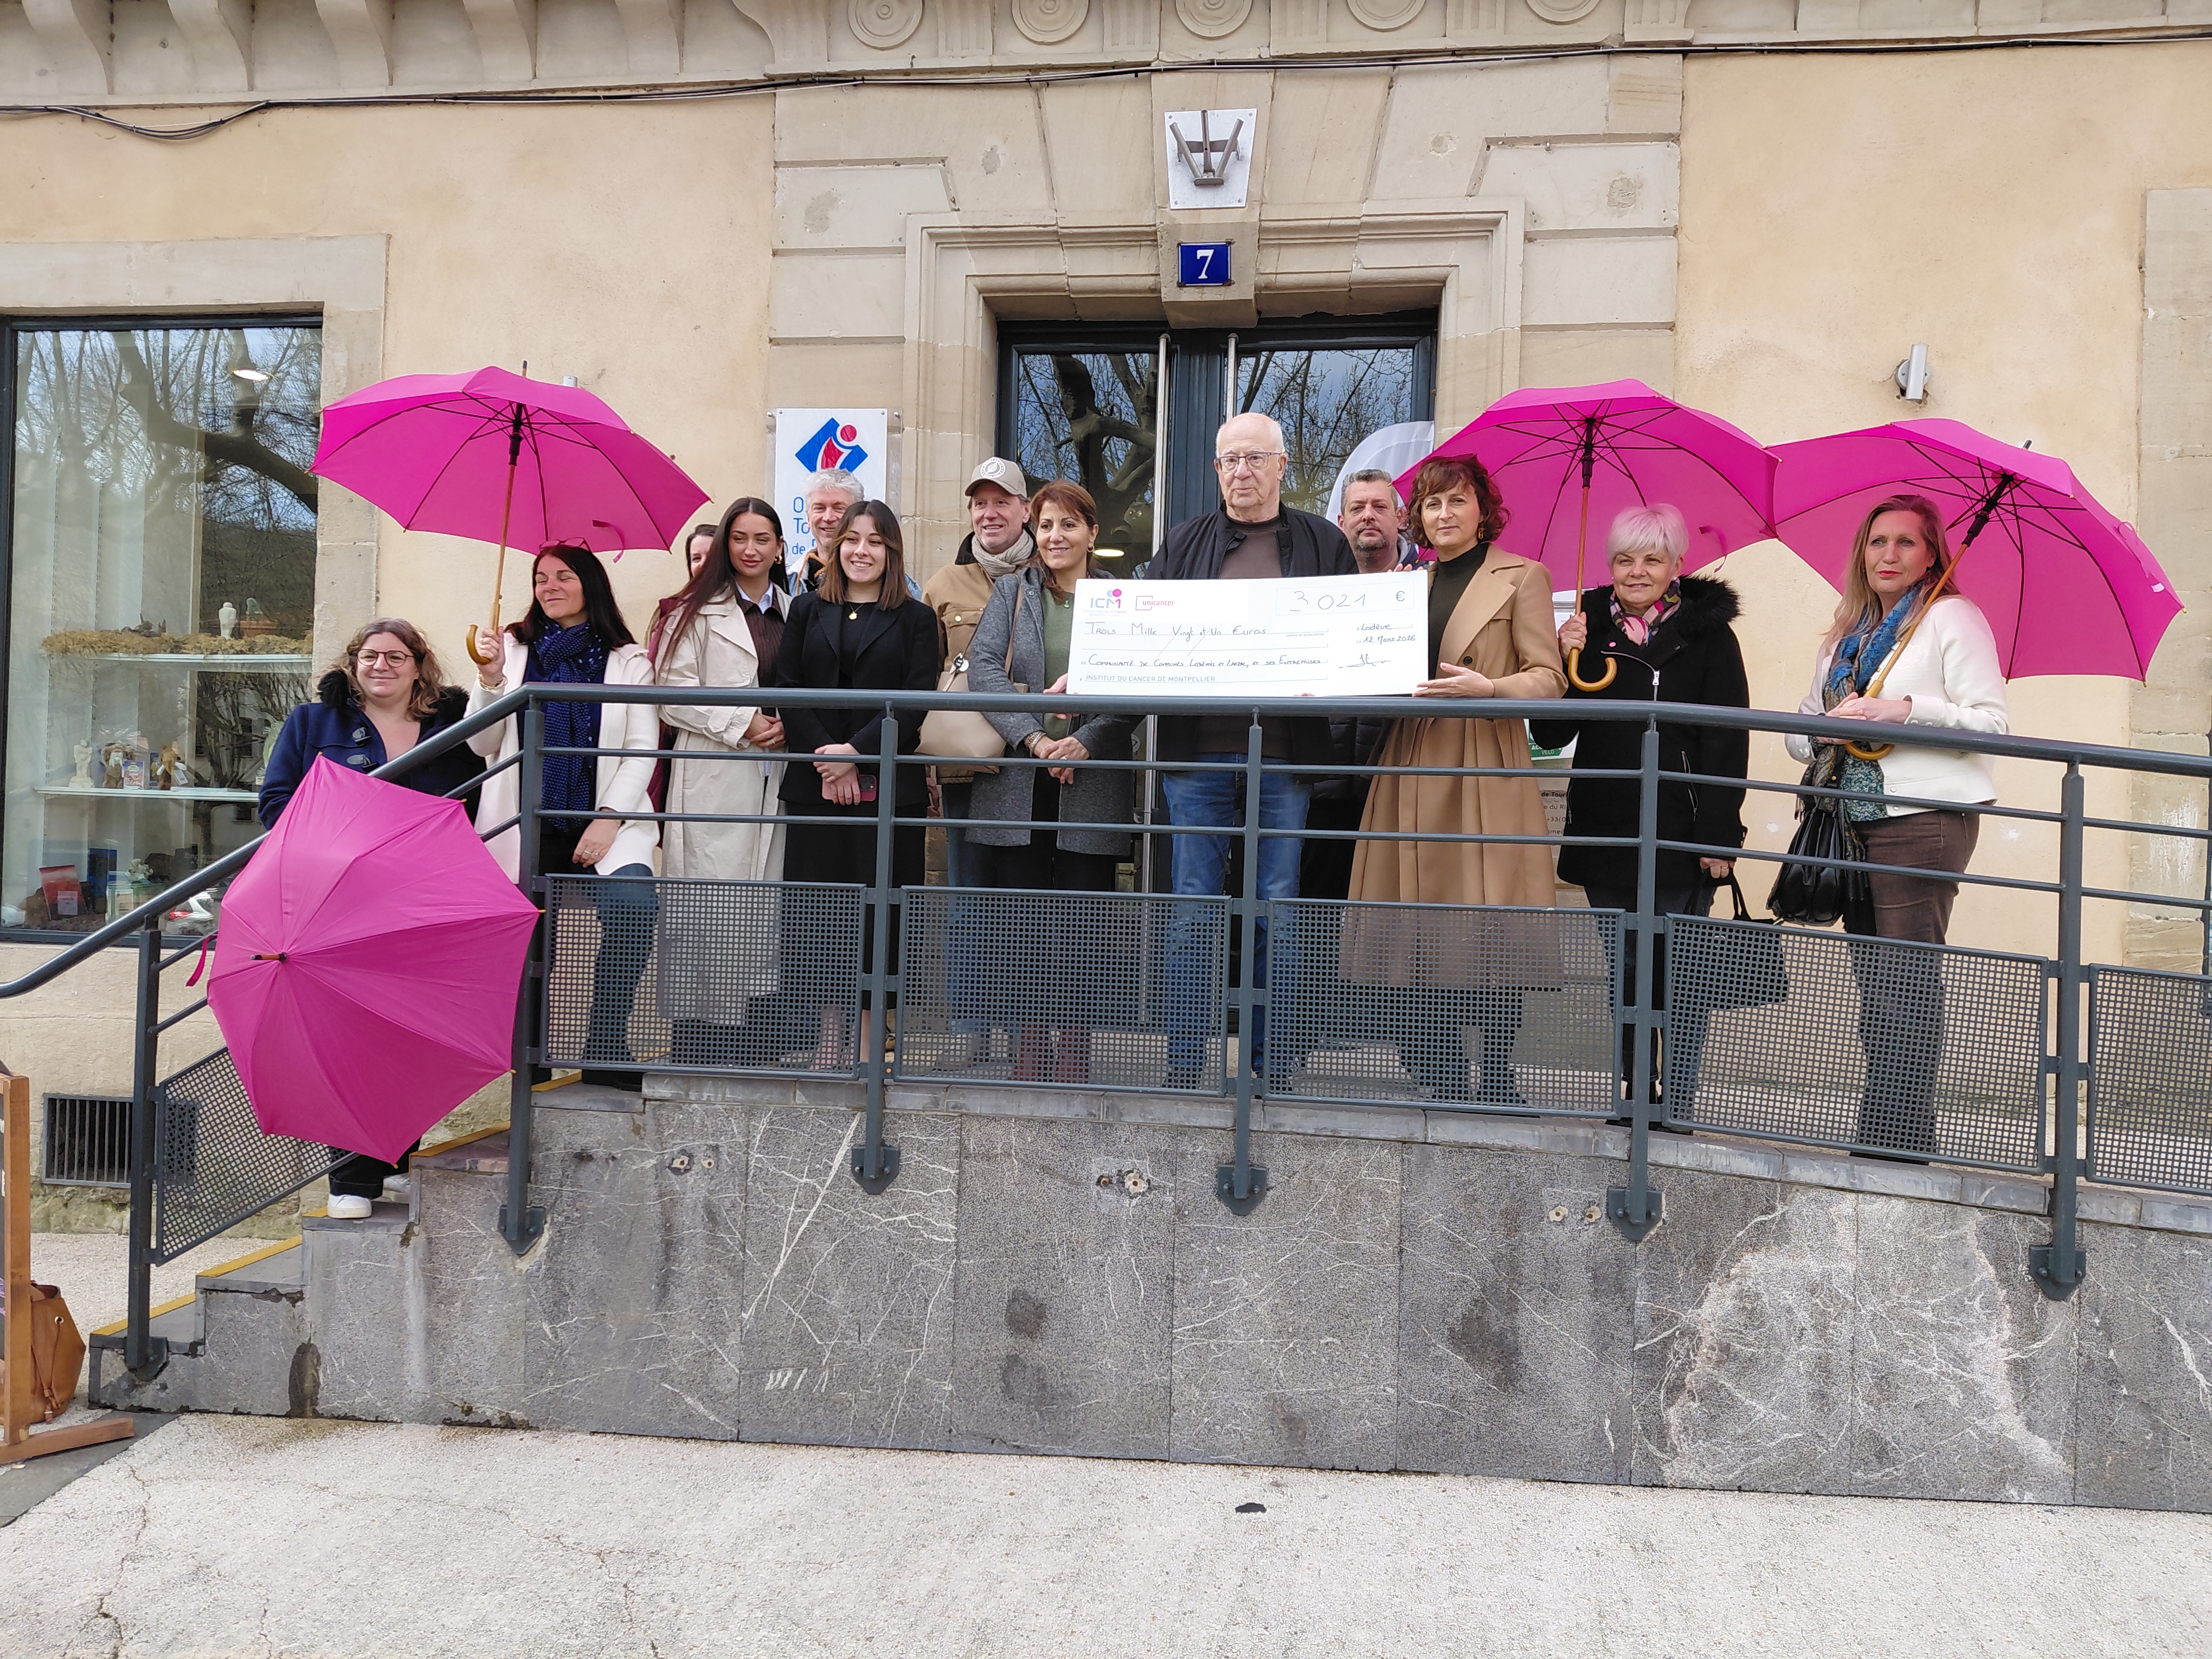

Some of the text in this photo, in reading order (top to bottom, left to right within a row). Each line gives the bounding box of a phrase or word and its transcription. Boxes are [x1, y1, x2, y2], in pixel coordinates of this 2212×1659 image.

[1197, 249, 1214, 279] 7
[793, 517, 810, 534] To
[792, 542, 806, 555] de
[1290, 590, 1405, 612] 3 021 €
[1131, 622, 1157, 635] Mille
[1172, 625, 1194, 642] Vingt
[1199, 627, 1207, 635] et
[1210, 627, 1221, 635] Un
